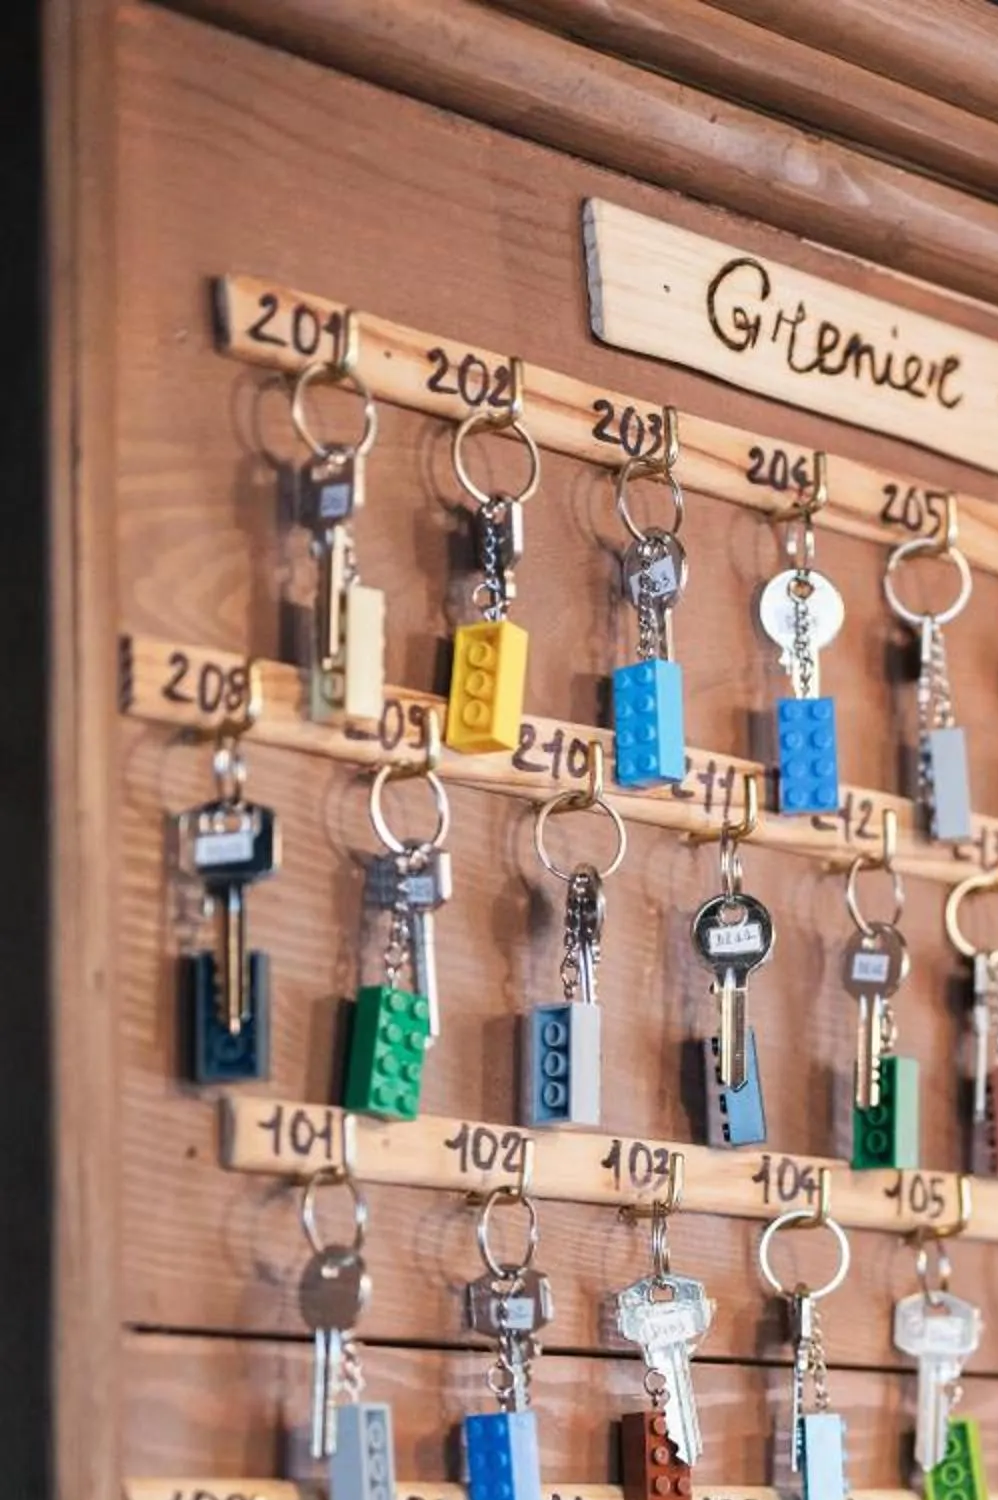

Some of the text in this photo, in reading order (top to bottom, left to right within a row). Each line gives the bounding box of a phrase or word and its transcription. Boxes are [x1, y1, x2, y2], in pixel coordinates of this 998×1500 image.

[248, 292, 342, 357] 201
[426, 348, 514, 407] 202
[592, 400, 663, 457] 203
[880, 484, 948, 537] 205
[162, 652, 249, 713] 208
[511, 723, 591, 779] 210
[257, 1106, 334, 1160] 101
[445, 1123, 523, 1173] 102
[601, 1140, 670, 1192] 103
[751, 1155, 820, 1204] 104
[884, 1169, 944, 1217] 105
